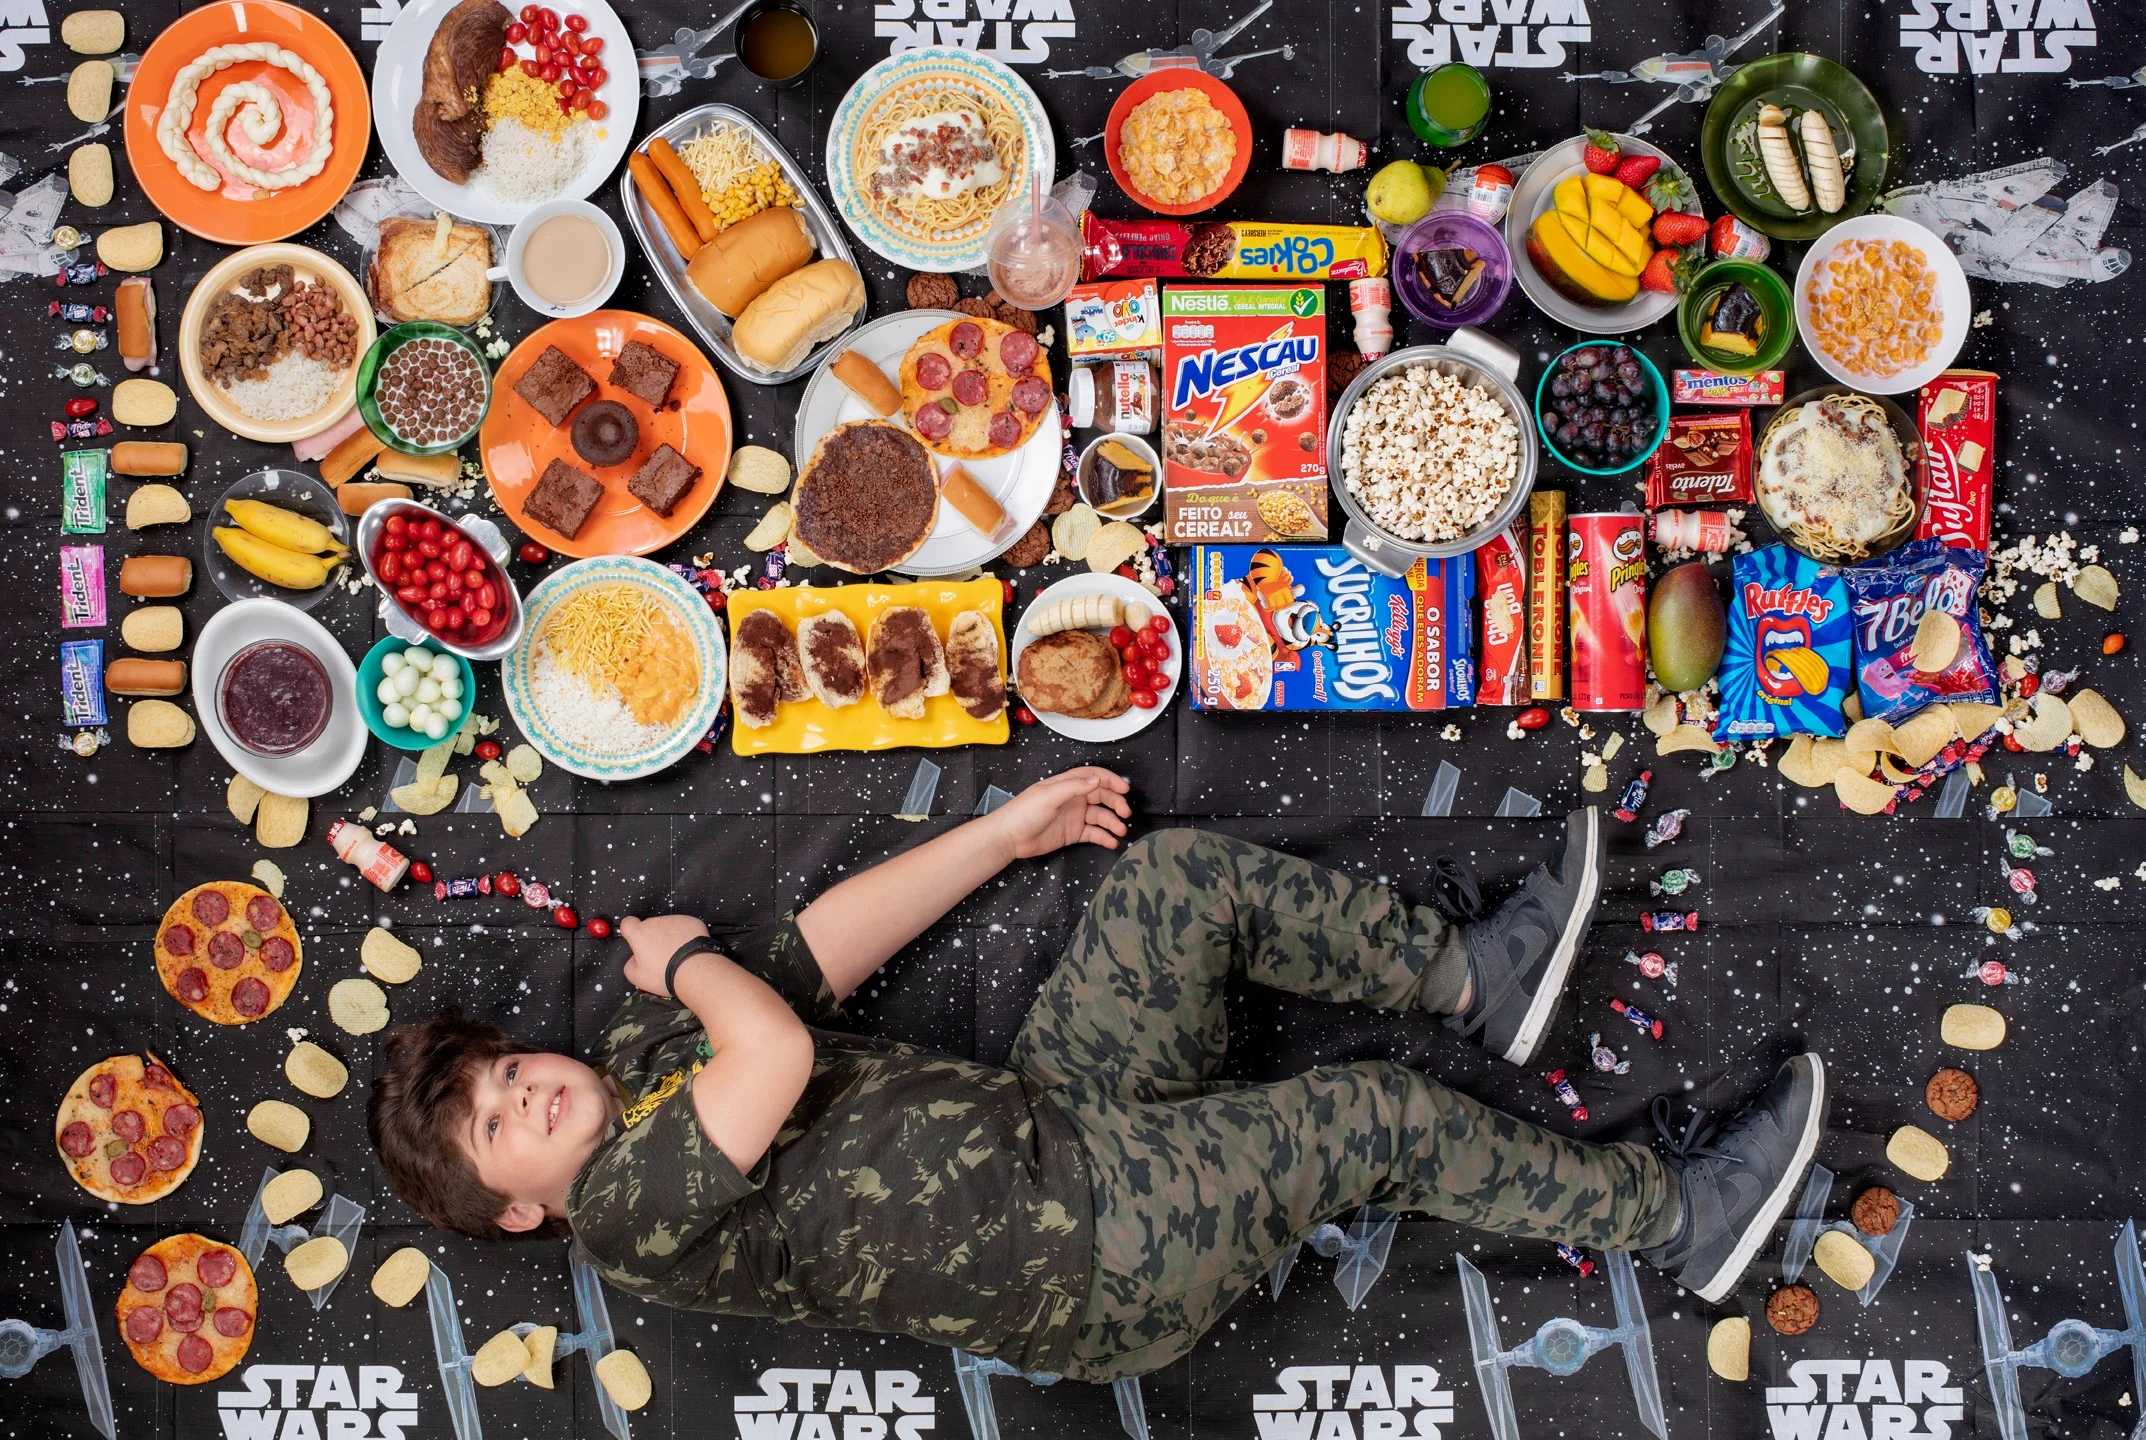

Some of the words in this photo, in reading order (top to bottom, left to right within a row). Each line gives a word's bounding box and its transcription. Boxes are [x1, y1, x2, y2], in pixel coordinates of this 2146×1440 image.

[874, 21, 1076, 64] STAR
[1391, 23, 1592, 68] STAR
[1899, 31, 2097, 74] STAR
[1240, 236, 1334, 274] Cookies
[1112, 300, 1141, 319] OVO
[1114, 314, 1145, 328] Kinder
[1171, 294, 1229, 312] Nestlé
[1174, 337, 1317, 408] NESCAU
[1270, 364, 1300, 380] Cereal
[1686, 375, 1748, 389] mentos
[1117, 373, 1130, 420] nutella
[1300, 464, 1326, 475] 270g
[1671, 473, 1735, 494] Talento
[70, 466, 90, 528] Trident
[1178, 506, 1223, 521] FEITO
[1227, 509, 1248, 520] seu
[1185, 492, 1208, 504] Do
[1208, 494, 1231, 506] que
[1231, 493, 1240, 503] é
[1967, 490, 1977, 507] Duo
[1174, 521, 1253, 538] CEREAL?
[67, 559, 90, 620] Trident
[1414, 557, 1425, 588] NERGIA
[1571, 584, 1593, 595] Original
[1610, 557, 1645, 593] Pringle
[1416, 595, 1425, 620] QUE
[1425, 606, 1440, 622] O
[1531, 522, 1548, 676] TOBLERONE
[1553, 522, 1563, 676] TOBLERONE
[1744, 582, 1834, 624] Ruffles
[1315, 558, 1395, 700] SUCRILHOS
[1386, 594, 1408, 657] Kellogg's
[1416, 622, 1425, 648] ELES
[1416, 650, 1425, 703] ADORAM
[1425, 626, 1440, 691] SABOR
[66, 663, 91, 722] Trident
[1207, 668, 1221, 694] 250
[1312, 658, 1328, 702] original!
[1452, 658, 1470, 701] SUCRILHOS
[1578, 692, 1591, 702] 121g
[1203, 696, 1218, 706] g
[1757, 690, 1793, 706] original
[217, 1364, 418, 1409] STAR
[733, 1368, 935, 1413] STAR
[1252, 1365, 1454, 1410] STAR
[1765, 1360, 1964, 1404] STAR
[217, 1409, 418, 1440] WARS
[1252, 1408, 1454, 1440] WARS
[1765, 1404, 1964, 1440] WARS
